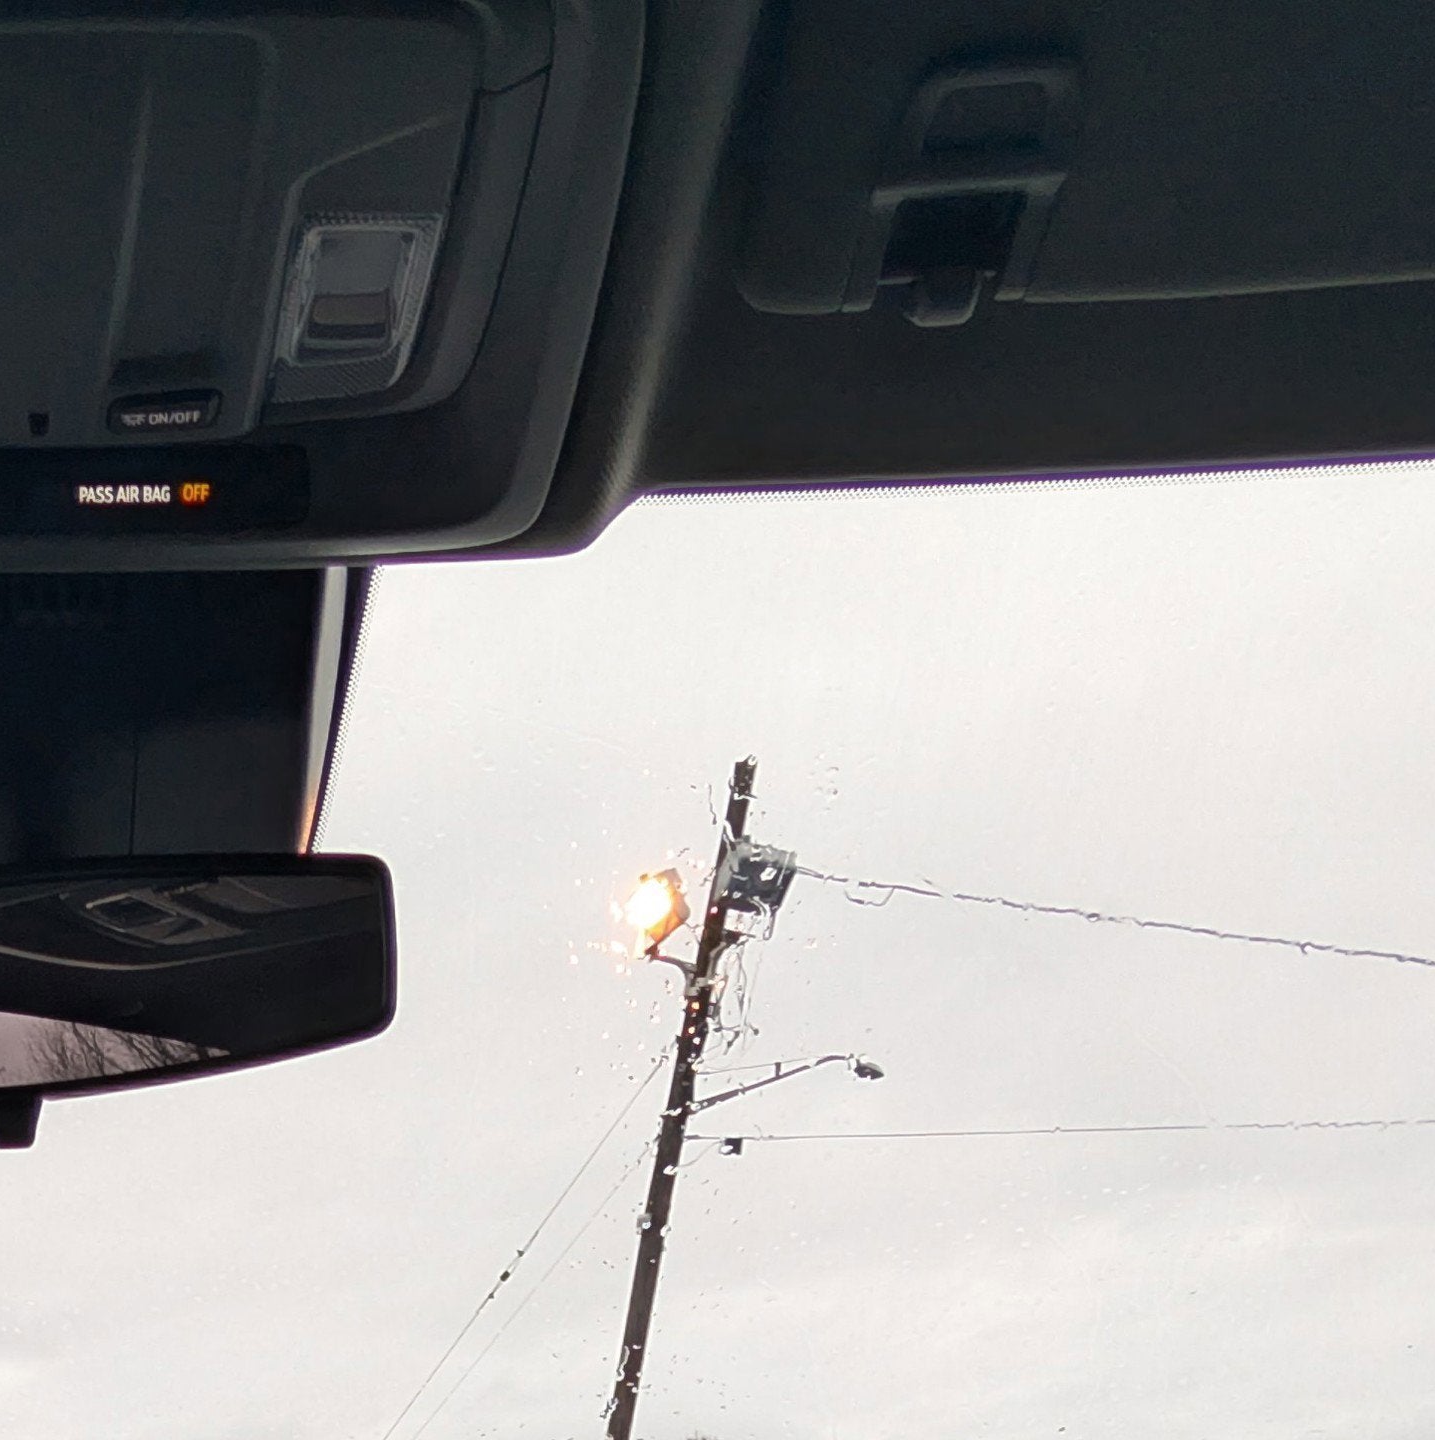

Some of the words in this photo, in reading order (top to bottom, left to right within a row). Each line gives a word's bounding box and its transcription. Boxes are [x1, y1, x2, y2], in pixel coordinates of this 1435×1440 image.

[148, 409, 201, 426] ON/OFF
[78, 484, 114, 505] PASS
[116, 484, 140, 504] AIR
[143, 483, 171, 504] BAG
[183, 482, 210, 502] OFF
